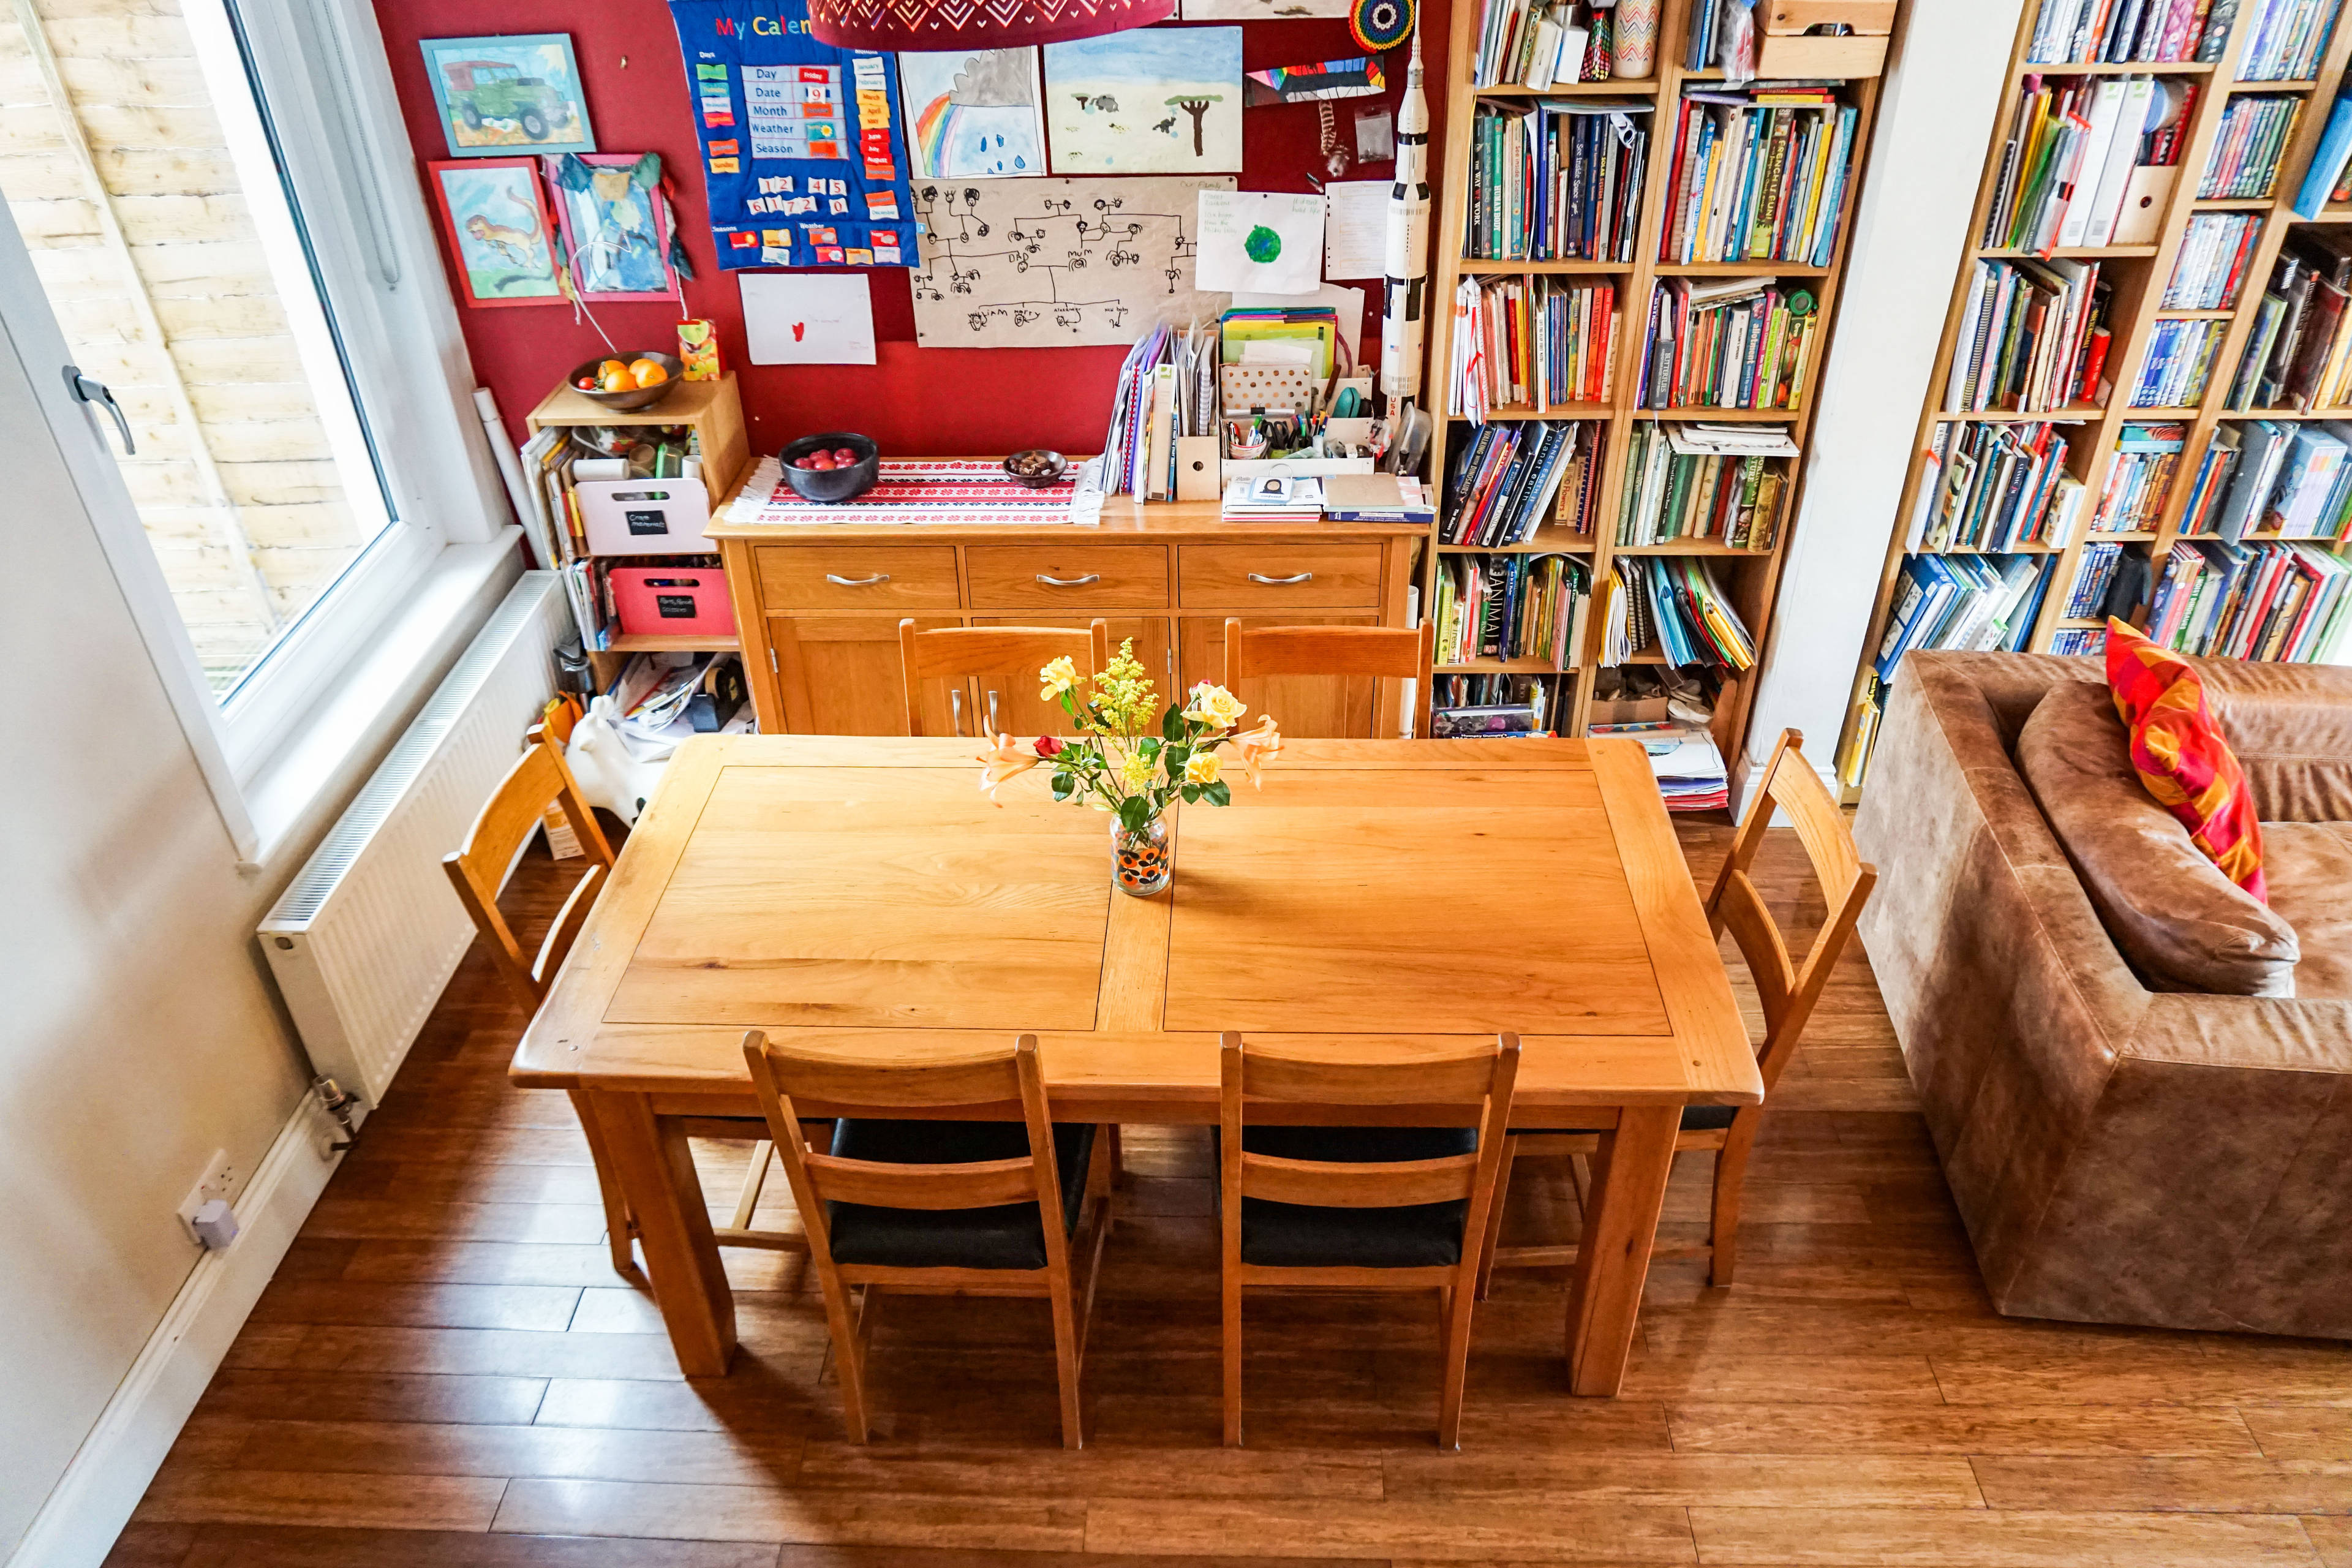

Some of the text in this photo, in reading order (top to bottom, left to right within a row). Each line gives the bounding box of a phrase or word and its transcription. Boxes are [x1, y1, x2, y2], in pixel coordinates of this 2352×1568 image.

[715, 15, 813, 40] My Calen
[756, 69, 777, 79] Day
[804, 72, 823, 80] Friday
[756, 88, 781, 97] Date
[812, 89, 821, 100] 9
[753, 106, 787, 116] Month
[752, 123, 793, 134] Weather
[756, 144, 793, 153] Season
[1772, 140, 1786, 182] FRENCH
[766, 179, 841, 193] 1 2 4 5
[752, 198, 842, 213] 6 1 7 2 0
[1765, 194, 1776, 220] FUN!
[1009, 252, 1029, 263] DAD
[1747, 323, 1760, 365] allotment
[1660, 352, 1671, 392] BUTTERFLIES
[1477, 431, 1491, 455] WALKING
[1546, 434, 1563, 466] PLANET
[1460, 465, 1477, 495] DINOSAURS
[1522, 435, 1552, 501] planet earth
[1536, 468, 1548, 495] EARTH
[1560, 486, 1571, 512] Flowers
[1447, 515, 1455, 530] Haines
[1490, 504, 1504, 529] FOSSILS
[2179, 578, 2204, 630] NOISY DINOSAURS
[1484, 645, 1498, 654] DK
